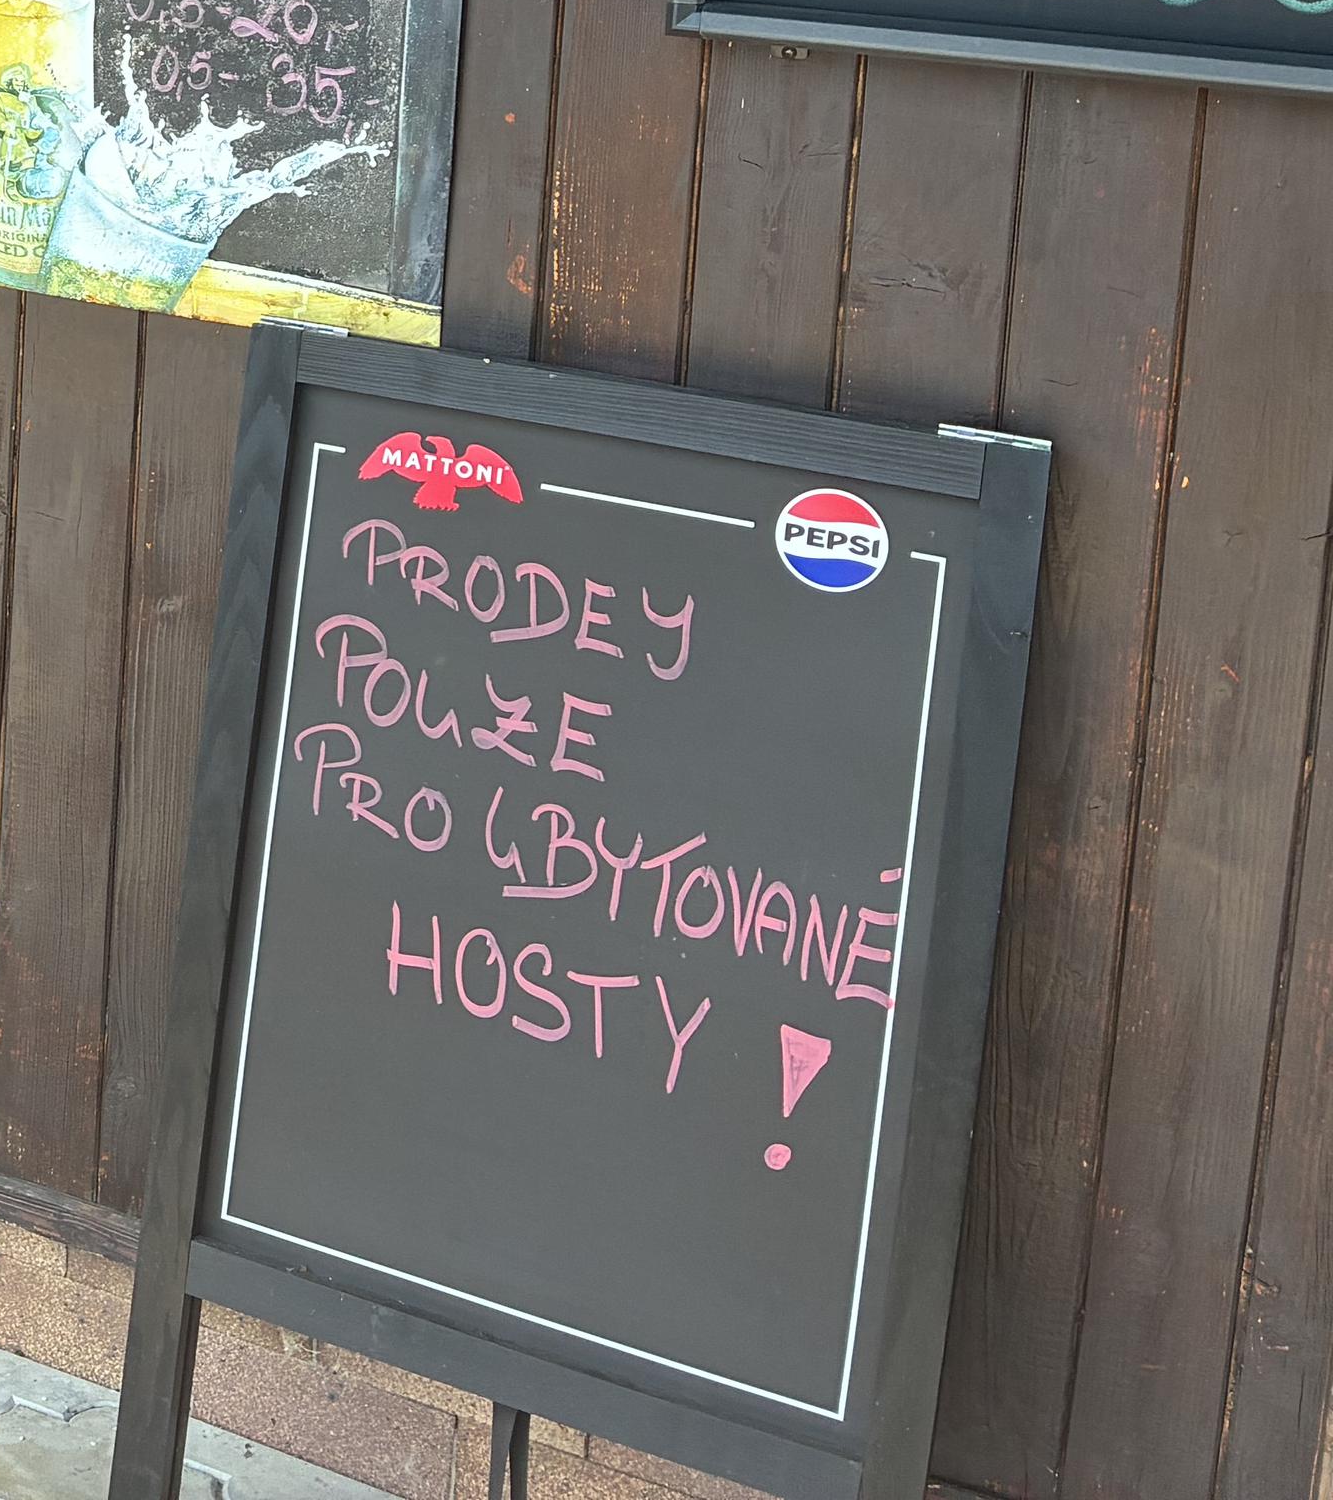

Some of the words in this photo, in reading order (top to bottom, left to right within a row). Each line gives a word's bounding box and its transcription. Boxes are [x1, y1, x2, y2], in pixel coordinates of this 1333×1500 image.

[381, 446, 508, 487] MATTONI
[783, 521, 882, 560] PEPSI
[315, 613, 614, 784] POUZE
[293, 722, 453, 853] PRO
[484, 786, 903, 1011] UBYTOVANÉ
